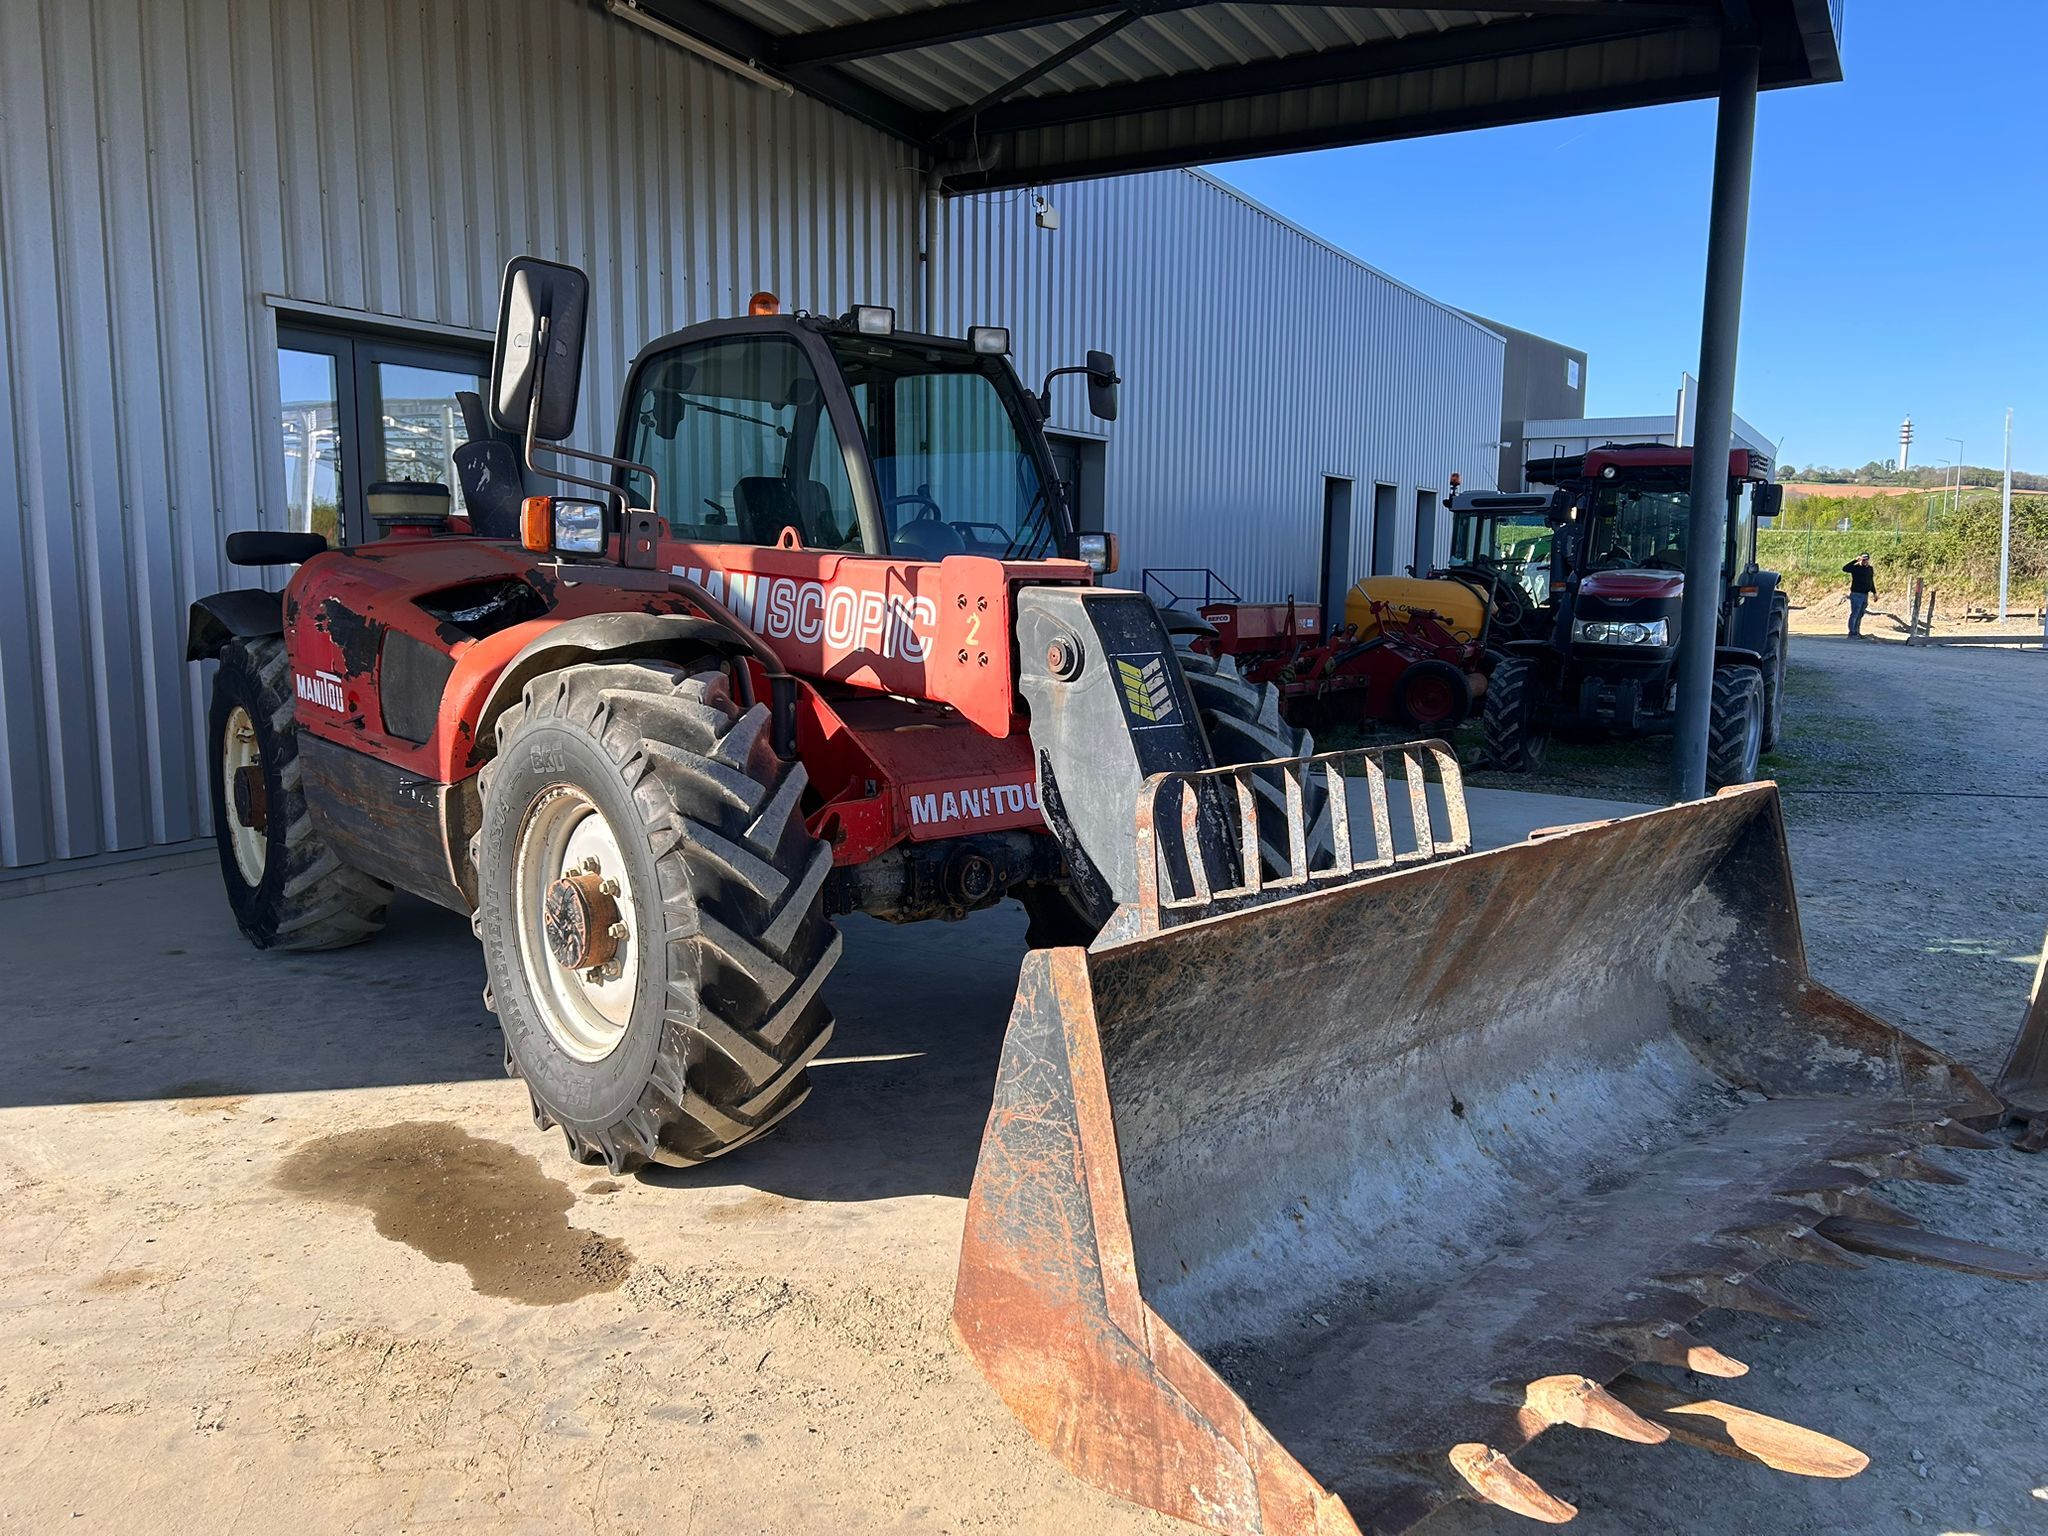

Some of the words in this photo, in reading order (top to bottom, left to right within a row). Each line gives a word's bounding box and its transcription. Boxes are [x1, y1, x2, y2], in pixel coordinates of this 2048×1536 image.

[965, 612, 981, 646] 2
[295, 669, 345, 713] MANITOU
[530, 743, 566, 774] BKT
[910, 782, 1041, 825] MANITOU
